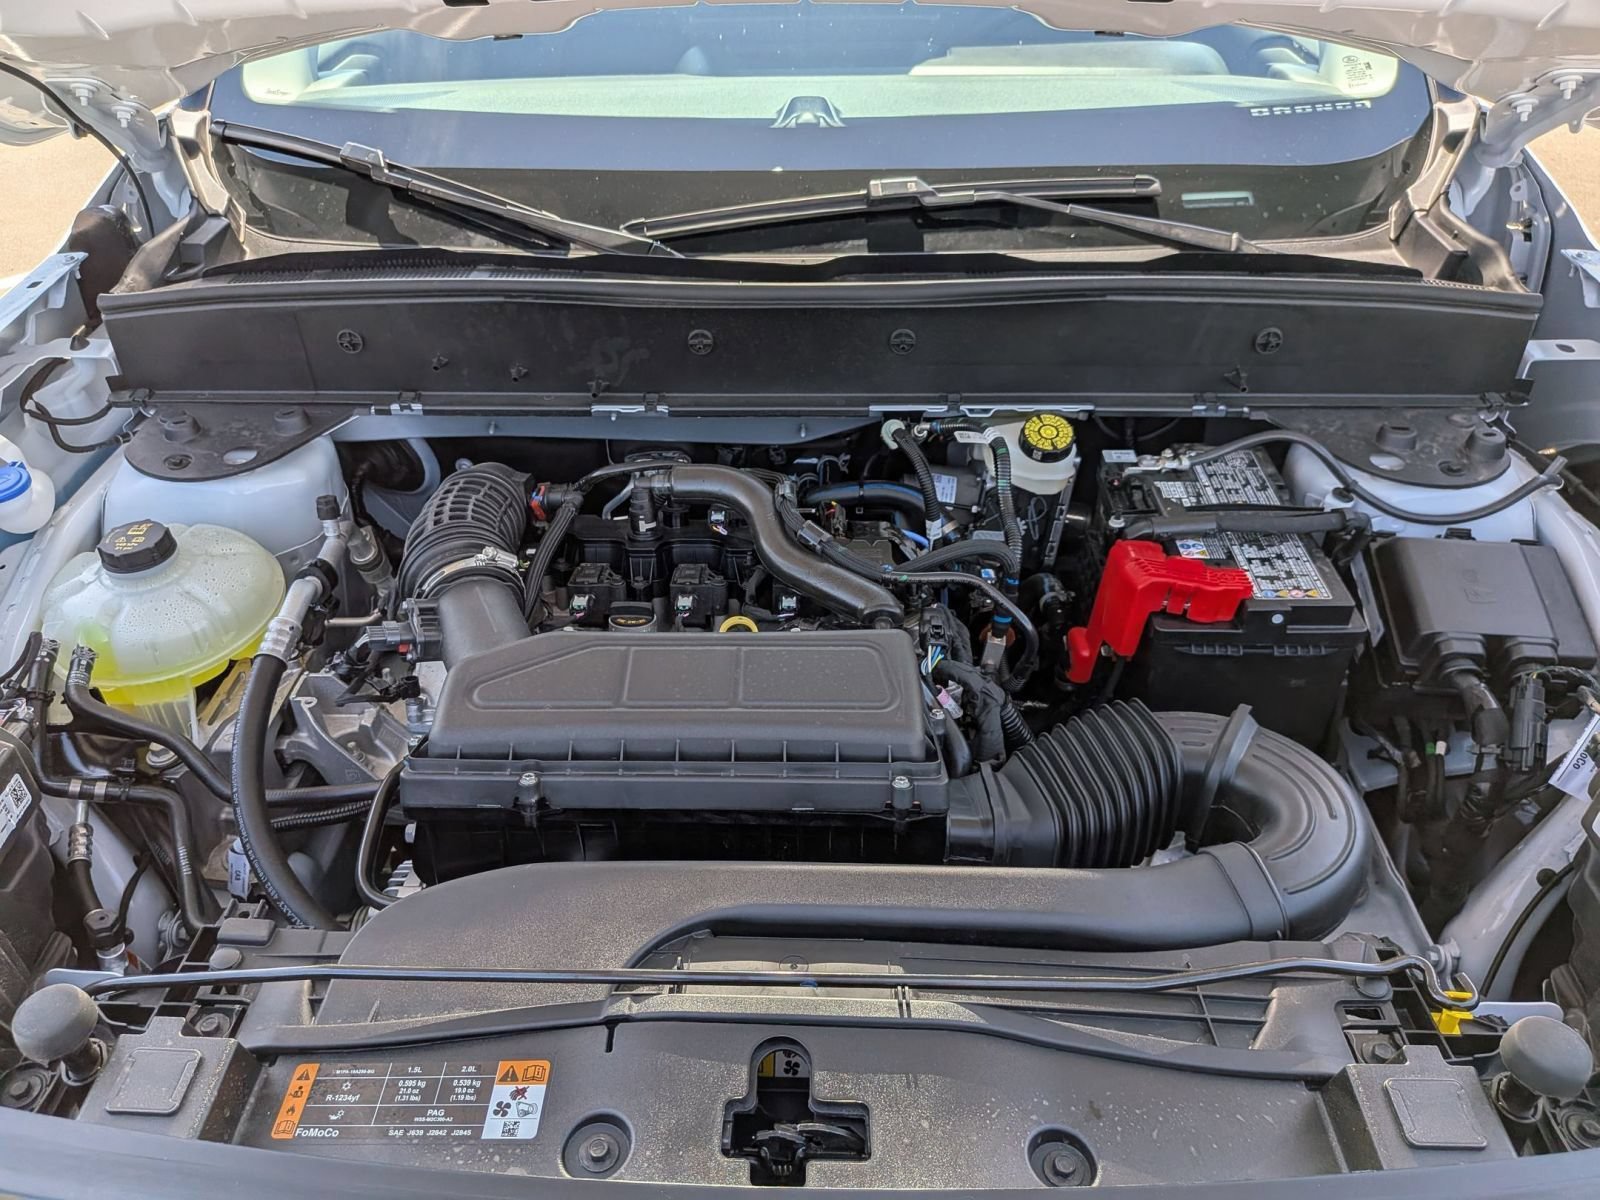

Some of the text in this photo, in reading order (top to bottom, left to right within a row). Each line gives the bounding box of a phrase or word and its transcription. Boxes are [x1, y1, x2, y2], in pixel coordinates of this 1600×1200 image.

[1572, 752, 1588, 770] oCo
[417, 1080, 427, 1088] kg
[453, 1079, 482, 1088] 0.539 kg
[326, 1093, 361, 1103] R-1234yf
[427, 1109, 446, 1117] PAG
[295, 1128, 340, 1137] FoMoCo
